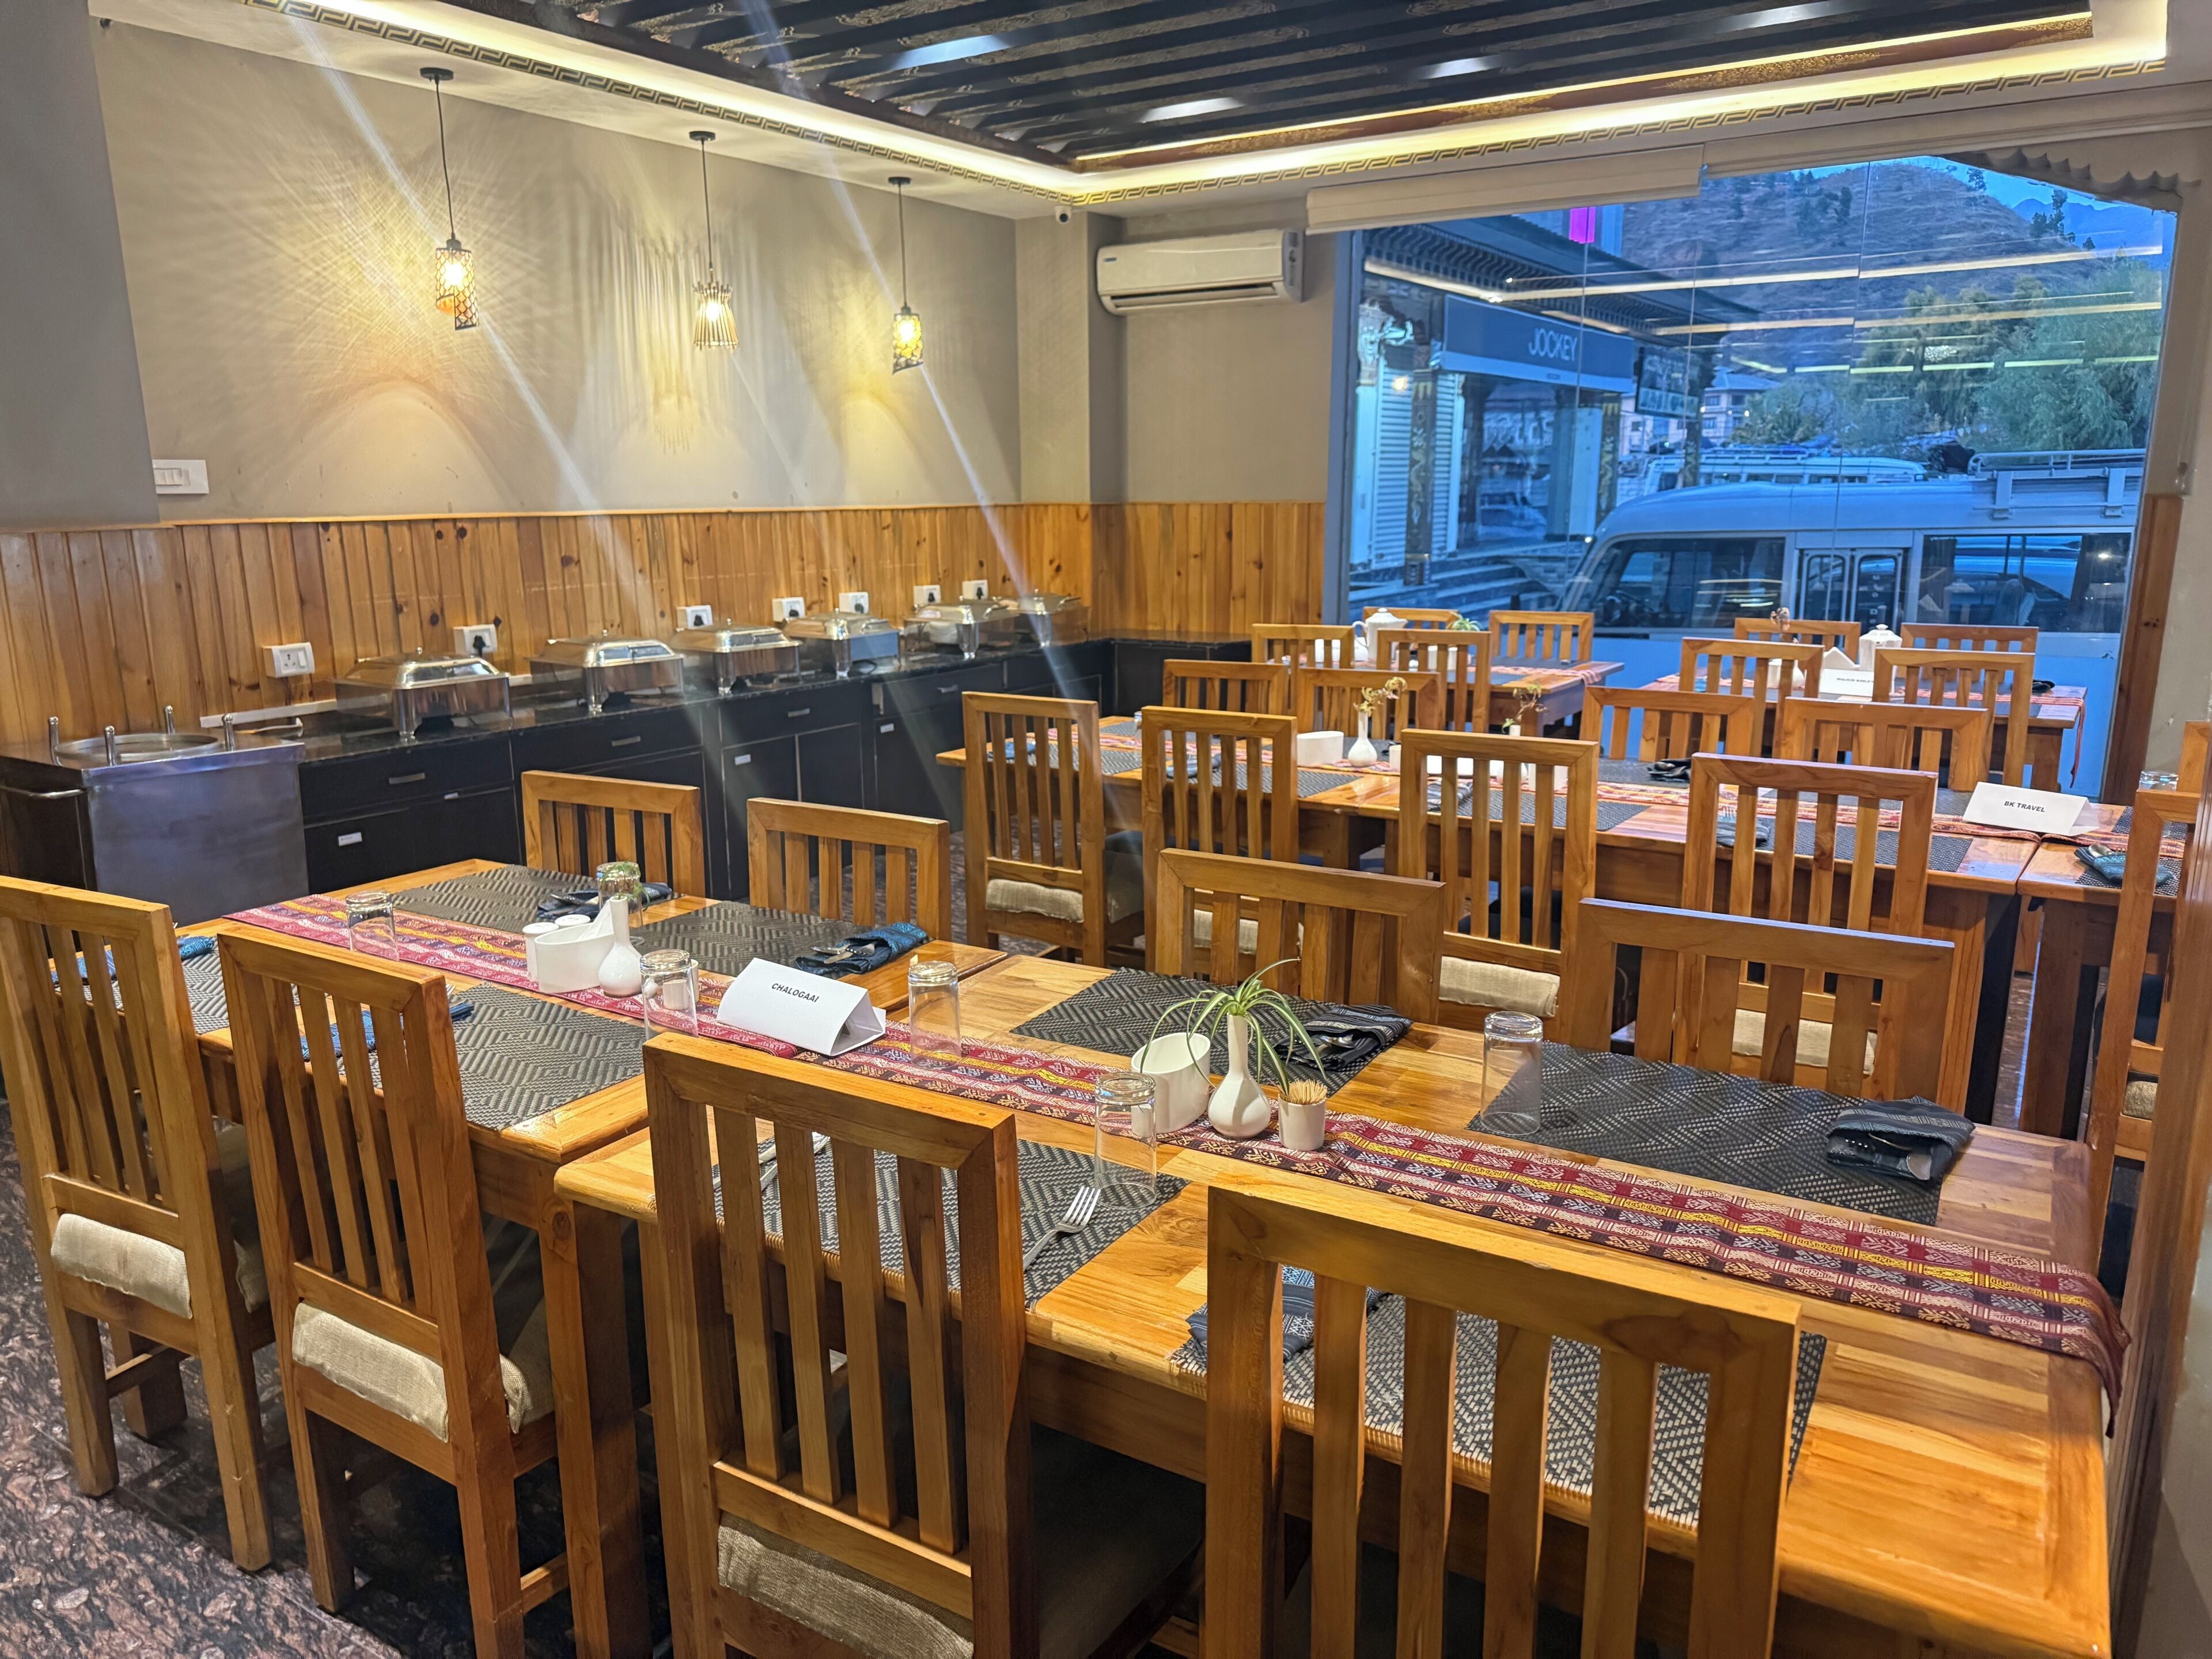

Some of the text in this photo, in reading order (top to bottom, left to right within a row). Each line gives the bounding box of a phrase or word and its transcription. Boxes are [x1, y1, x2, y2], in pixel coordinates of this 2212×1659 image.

[1528, 327, 1578, 361] JOCKEY
[2017, 802, 2045, 812] TRAVEL
[771, 983, 820, 1003] CHALOGAAI
